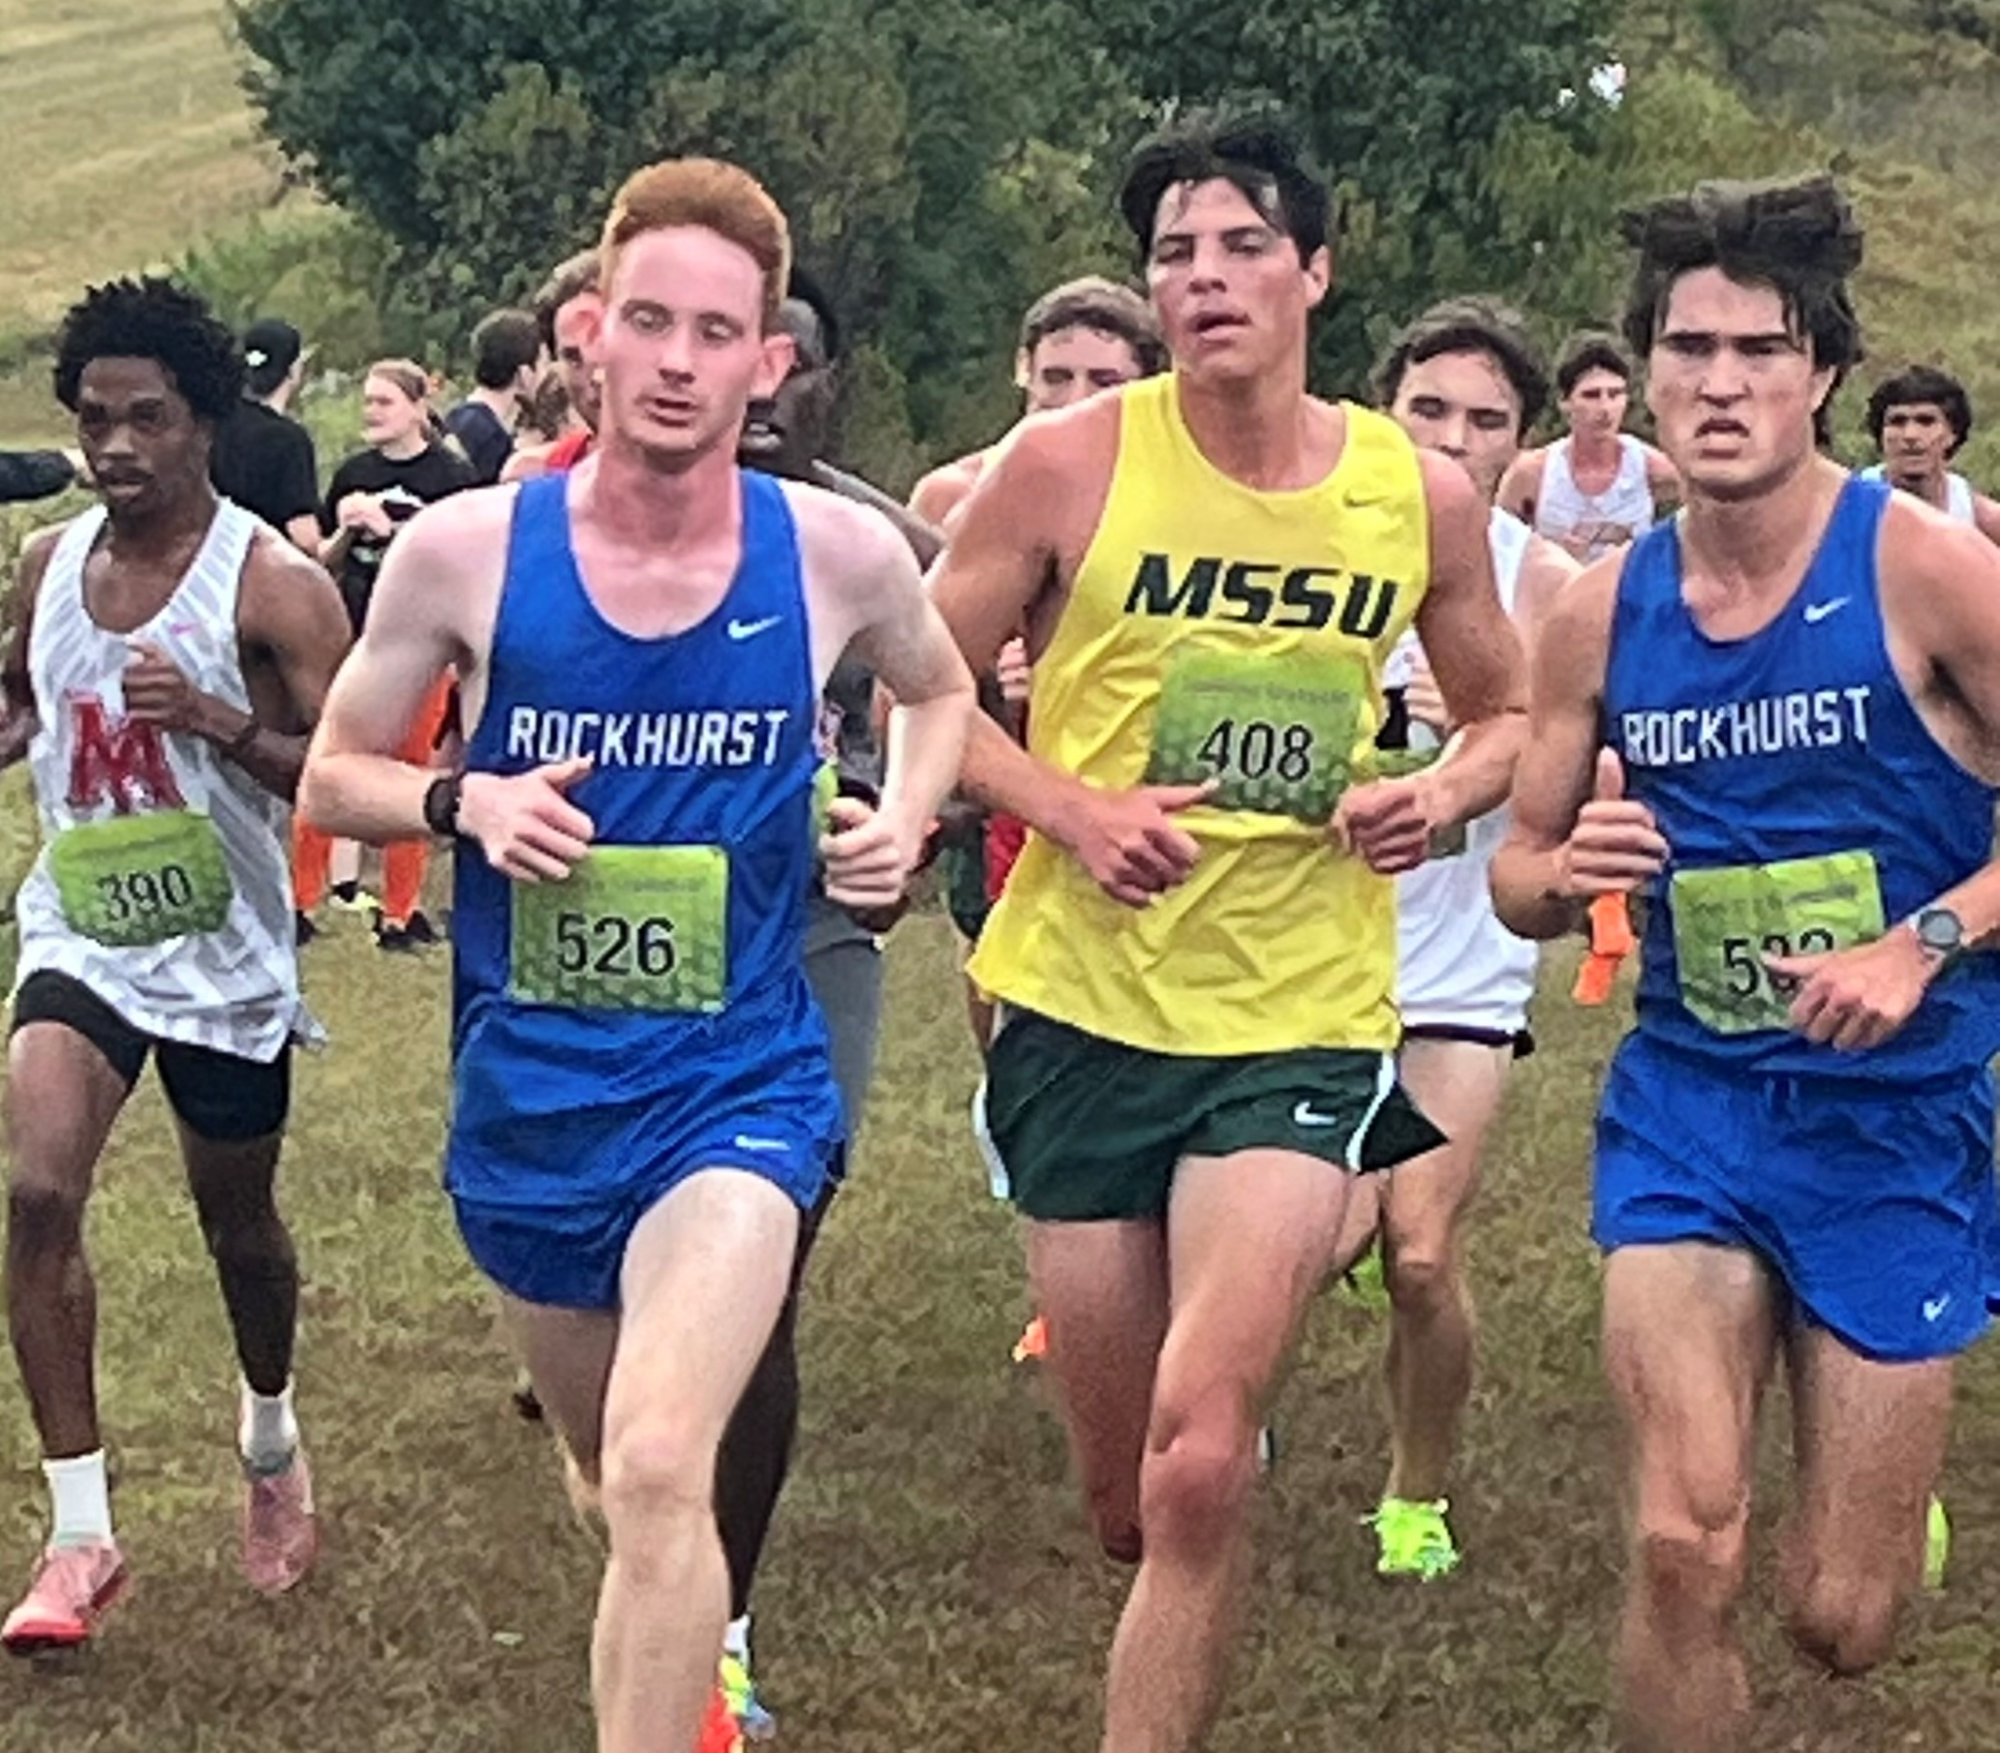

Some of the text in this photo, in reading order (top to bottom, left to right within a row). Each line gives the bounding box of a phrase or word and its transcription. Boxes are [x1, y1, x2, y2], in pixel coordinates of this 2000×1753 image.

[1123, 552, 1398, 639] MSSU
[507, 706, 790, 767] ROCKHURST
[1197, 717, 1313, 782] 408
[1621, 685, 1871, 767] ROCKHURST
[96, 864, 194, 922] 390
[556, 911, 676, 977] 526
